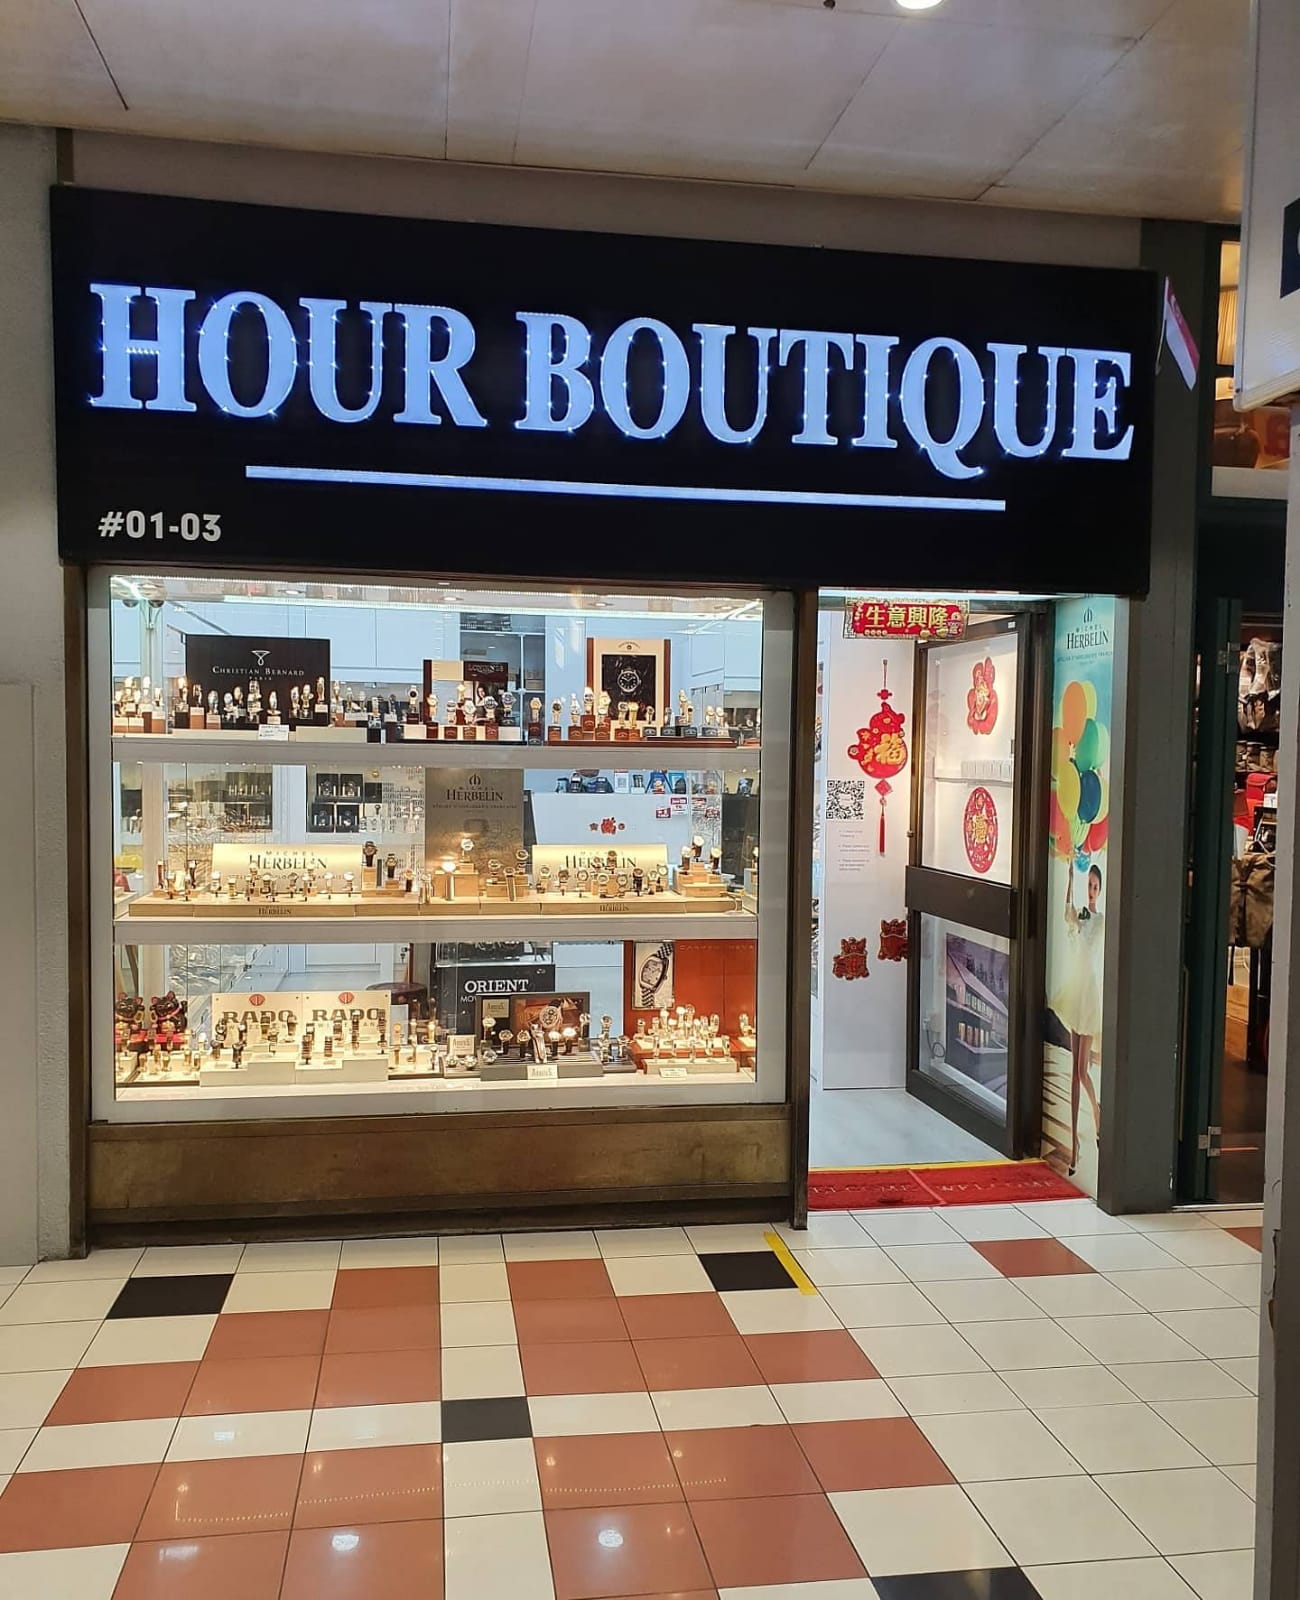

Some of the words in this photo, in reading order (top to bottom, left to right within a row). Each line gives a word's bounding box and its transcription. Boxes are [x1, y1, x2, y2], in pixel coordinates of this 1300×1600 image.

[88, 281, 490, 430] HOUR
[513, 309, 1135, 480] BOUTIQUE
[98, 510, 223, 542] #01-03
[864, 604, 949, 630] 生意興隆
[1067, 631, 1109, 650] HERBELIN
[212, 665, 260, 675] CHRISTIAN
[265, 667, 305, 677] BERNARD
[447, 789, 504, 802] HERBELIN
[464, 979, 529, 993] ORIENT
